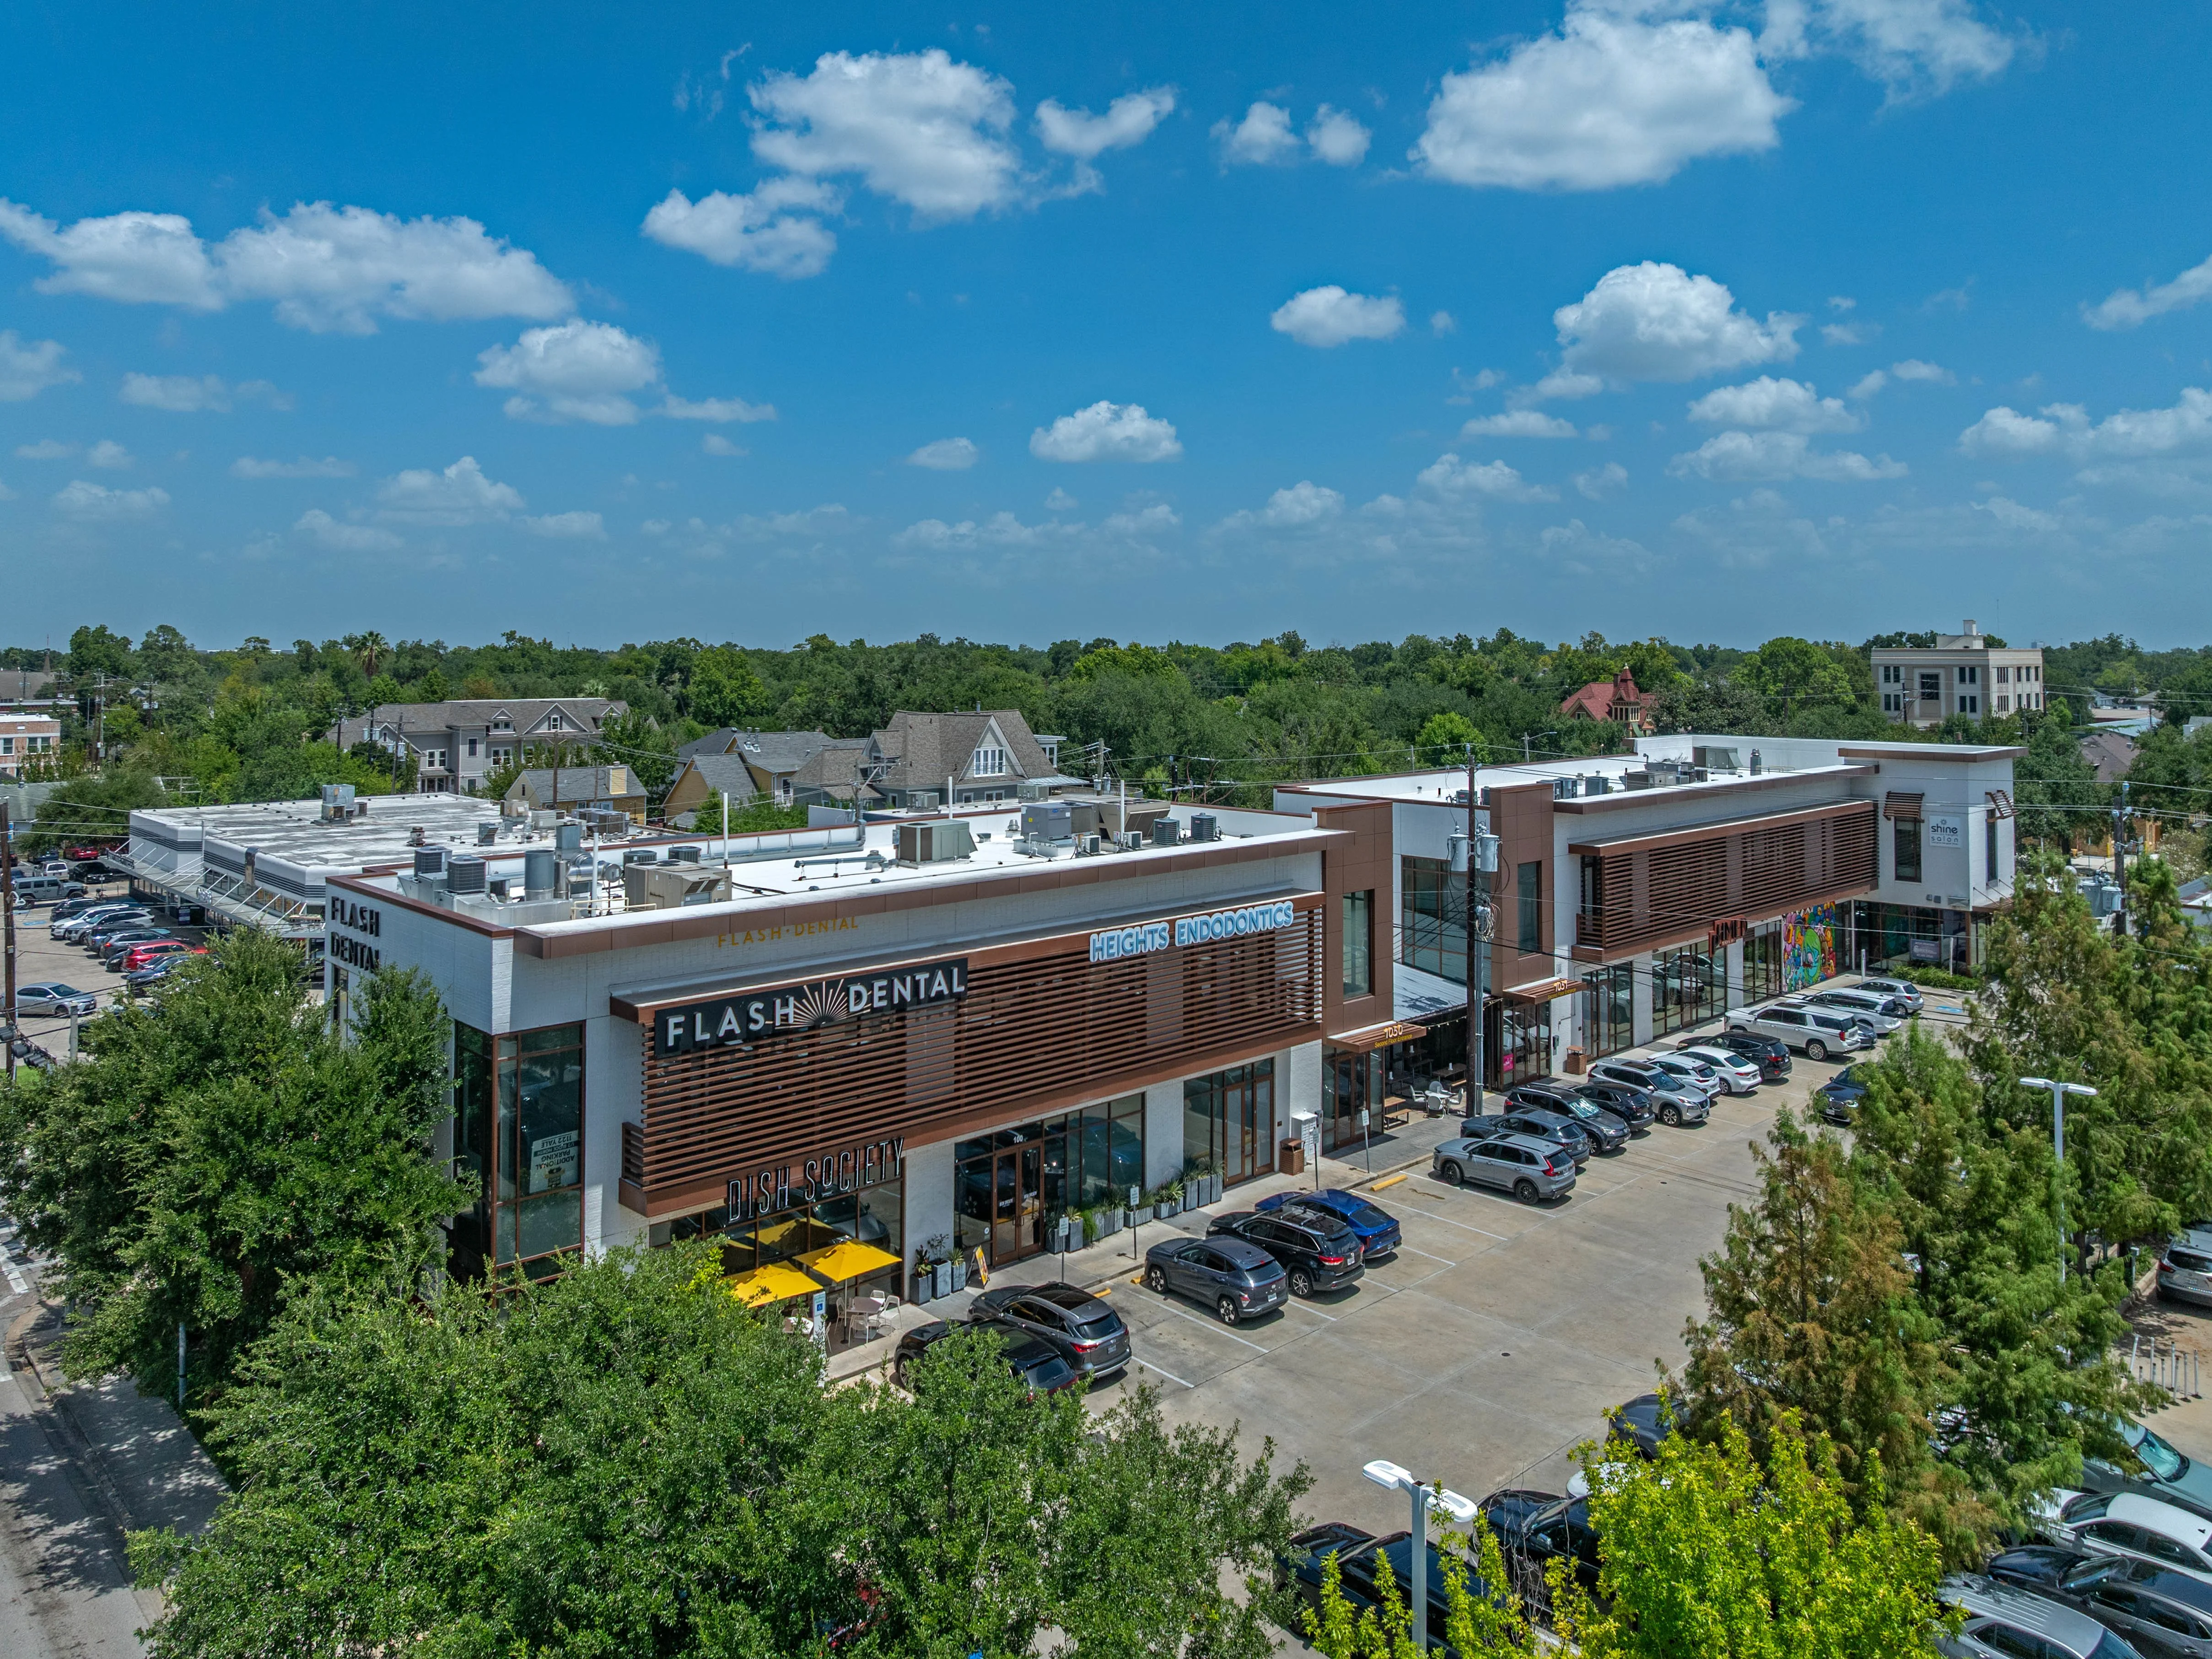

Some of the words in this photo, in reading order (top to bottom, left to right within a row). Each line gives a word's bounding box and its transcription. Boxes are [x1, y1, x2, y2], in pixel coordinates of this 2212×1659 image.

[1931, 824, 1958, 834] shine
[331, 896, 380, 937] FLASH
[717, 926, 782, 948] FLASH
[794, 916, 859, 937] DENTAL
[1090, 921, 1169, 962] HEIGHTS
[1175, 900, 1294, 946] ENDODONTICS
[666, 995, 795, 1047] FLASH
[847, 966, 965, 1013] DENTAL
[541, 1139, 556, 1148] YALE
[558, 1135, 572, 1144] 1122
[1013, 1135, 1023, 1143] 100
[535, 1154, 575, 1170] ADDITIONAL
[541, 1149, 570, 1162] PARKING
[728, 1166, 791, 1224] DISH
[804, 1137, 905, 1201] SOCIETY
